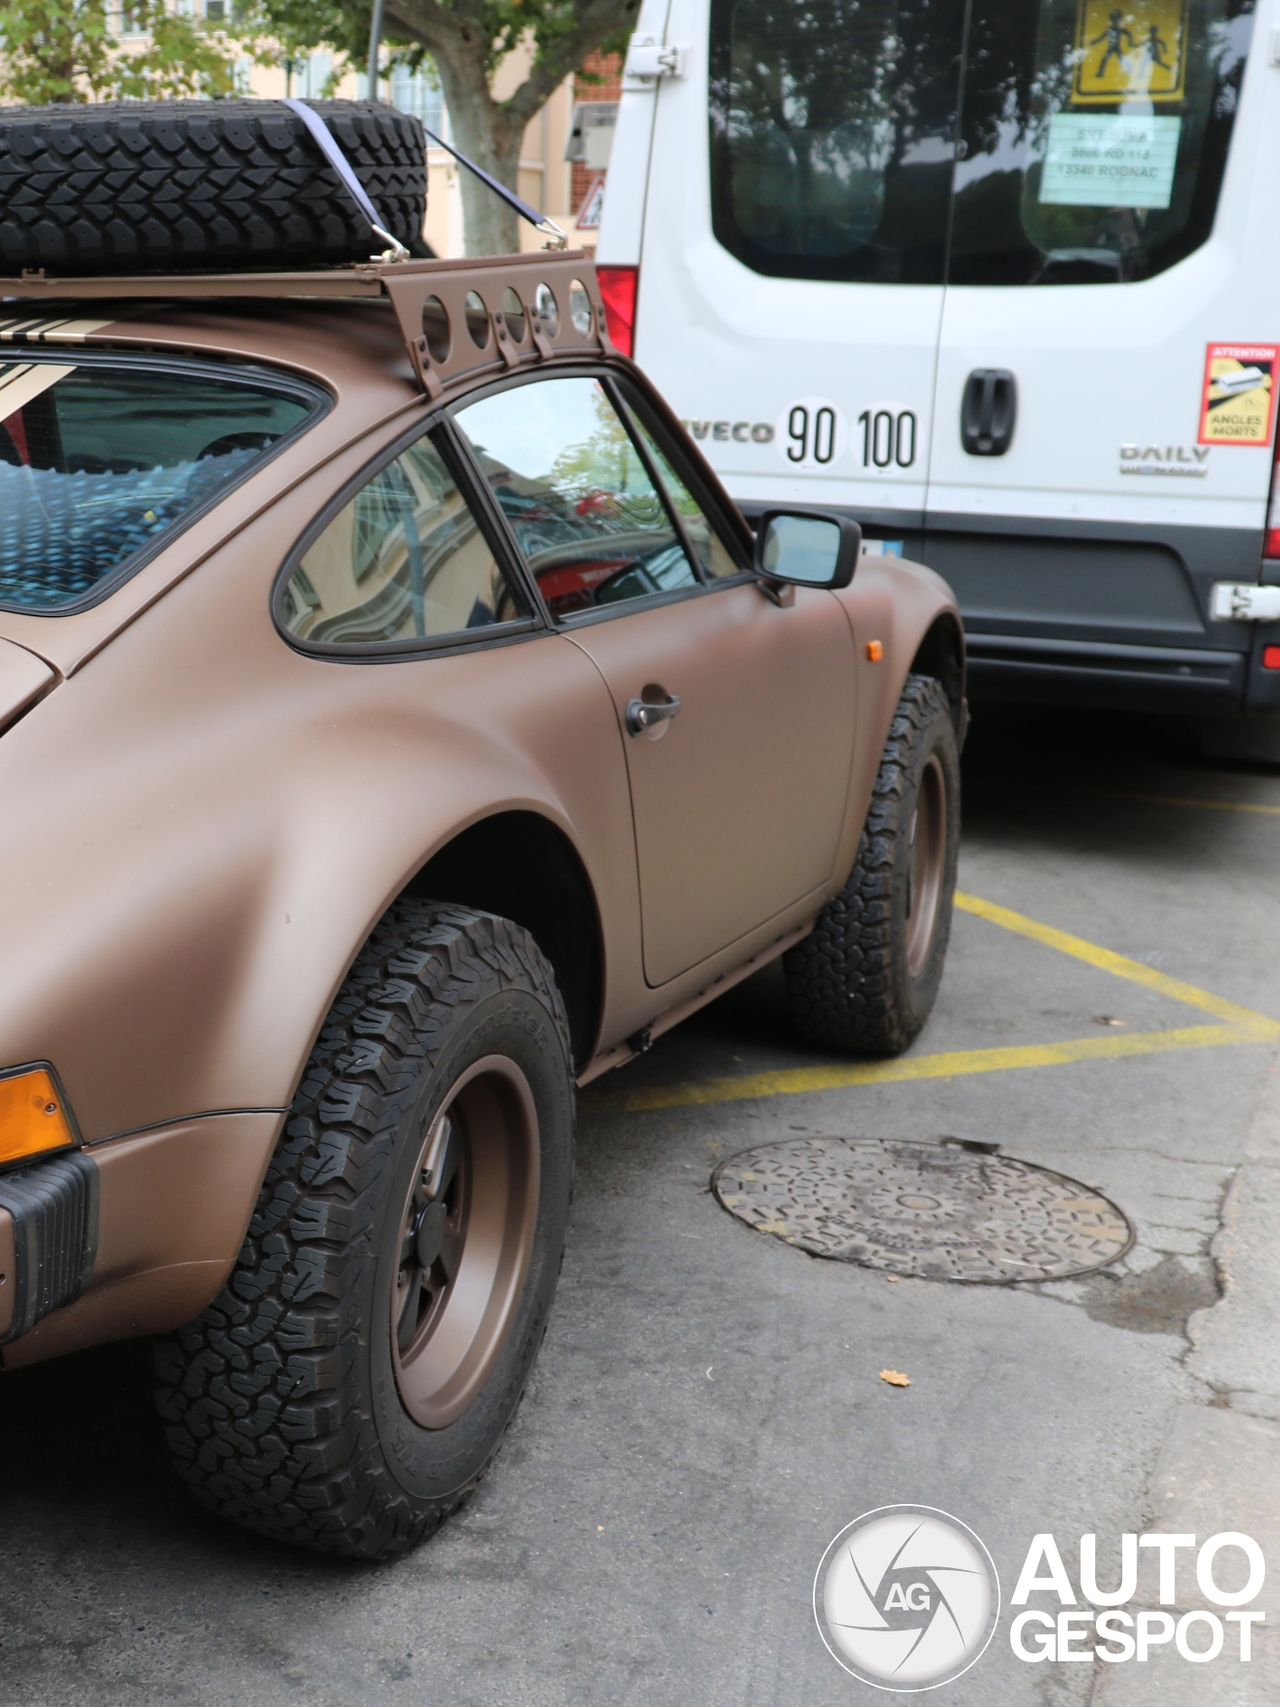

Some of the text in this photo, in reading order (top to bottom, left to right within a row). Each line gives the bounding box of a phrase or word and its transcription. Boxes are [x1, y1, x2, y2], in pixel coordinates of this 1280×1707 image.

[1099, 165, 1159, 178] ROGNAC
[1213, 346, 1276, 359] ATTENTION
[1212, 414, 1263, 425] ANGLES
[787, 405, 836, 464] 90
[1213, 426, 1258, 437] MORTS
[858, 409, 918, 468] 100
[1120, 442, 1211, 463] DAILY
